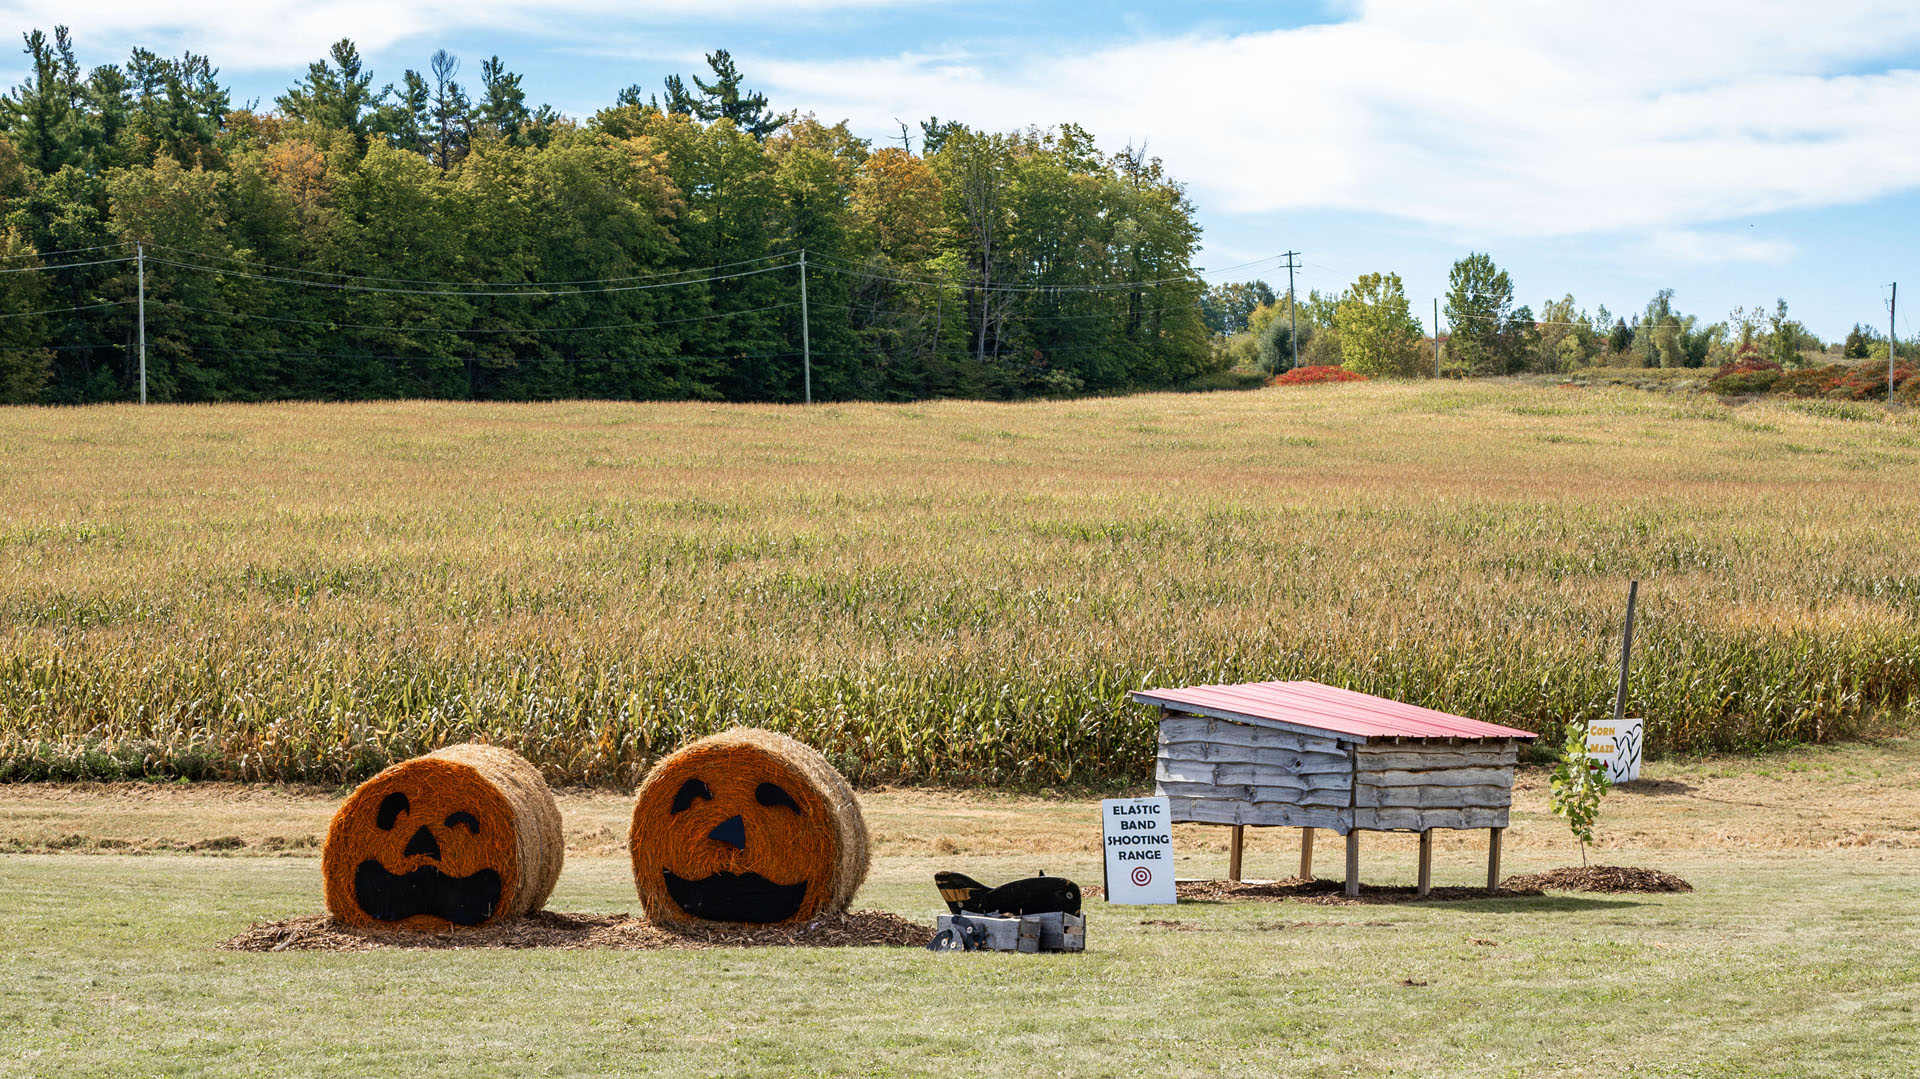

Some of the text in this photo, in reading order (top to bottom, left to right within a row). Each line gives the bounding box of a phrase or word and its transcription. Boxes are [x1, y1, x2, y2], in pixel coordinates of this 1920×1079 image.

[1113, 805, 1160, 815] ELASTIC
[1121, 821, 1156, 830] BAND
[1108, 835, 1169, 845] SHOOTING
[1119, 850, 1161, 860] RANGE
